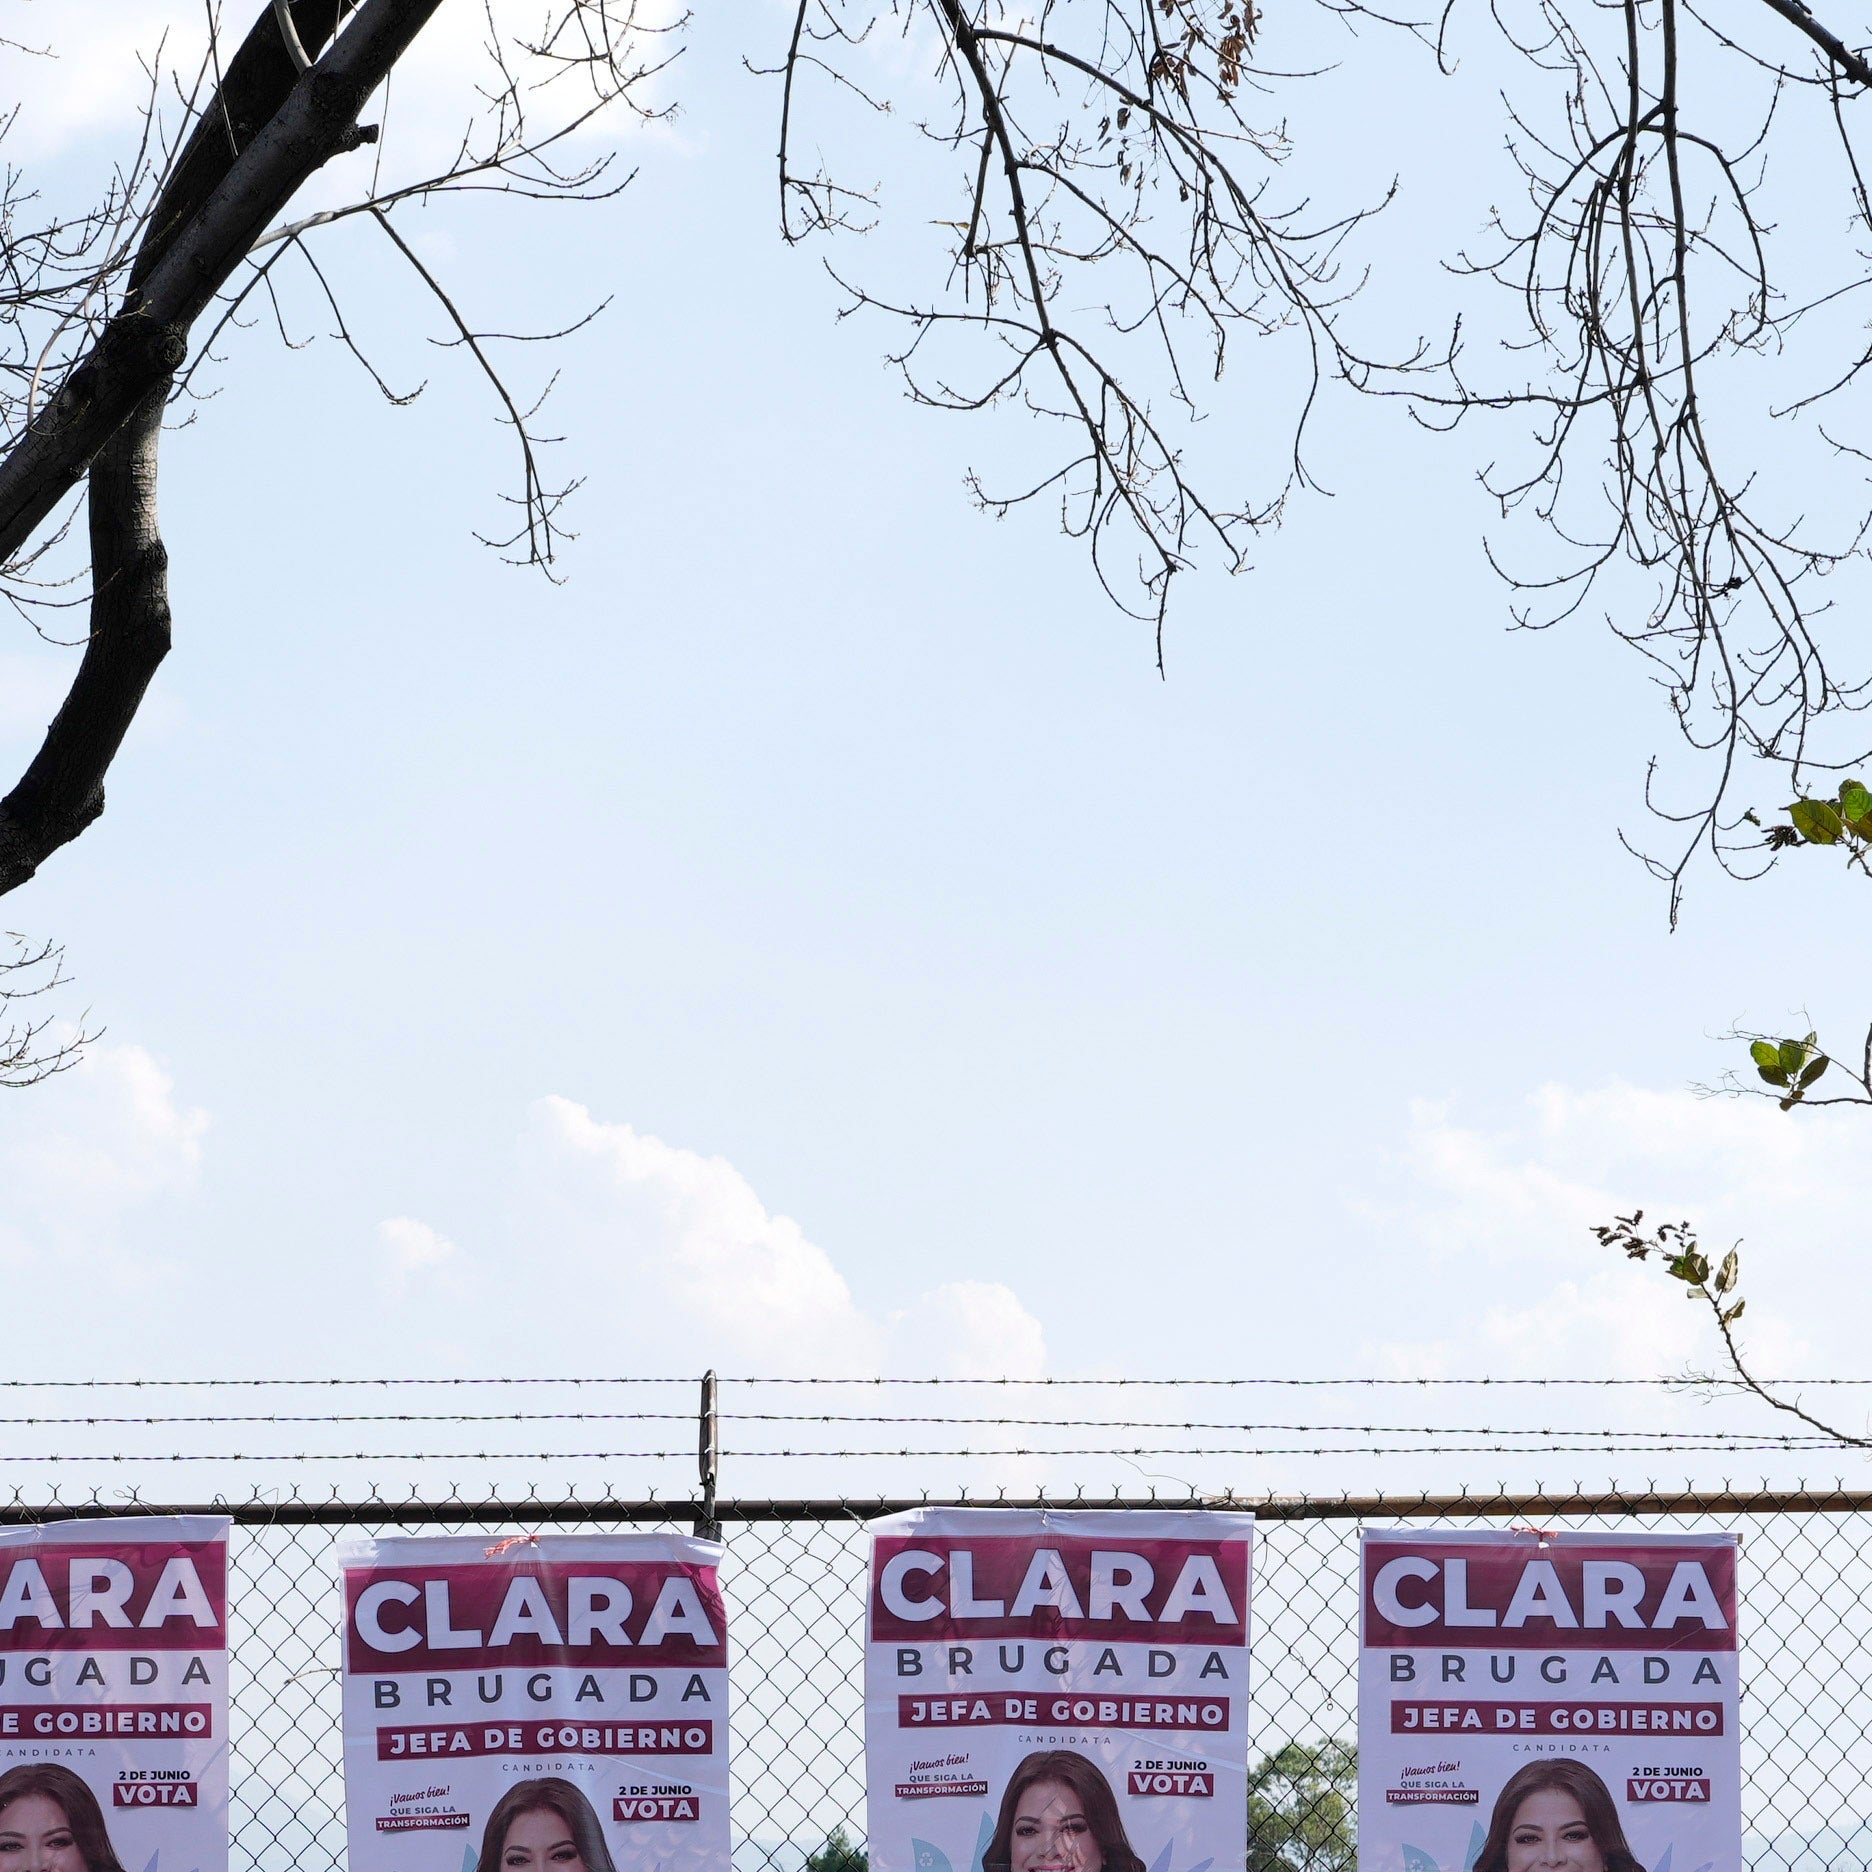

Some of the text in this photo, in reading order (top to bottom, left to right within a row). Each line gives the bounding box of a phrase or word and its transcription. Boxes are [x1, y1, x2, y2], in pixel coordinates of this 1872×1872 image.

[879, 1547, 1239, 1626] CLARA
[1373, 1555, 1730, 1631] CLARA
[353, 1575, 720, 1655] CLARA
[897, 1645, 1230, 1680] BRUGADA
[1389, 1654, 1723, 1686] BRUGADA
[374, 1674, 713, 1710] BRUGADA
[34, 1711, 207, 1734] GOBIERNO
[911, 1699, 1224, 1725] JEFA DE GOBIERNO
[1403, 1707, 1718, 1731] JEFA DE GOBIERNO
[389, 1726, 707, 1755] JEFA DE GOBIERNO
[1512, 1744, 1611, 1753] CANDIDATA
[1632, 1767, 1704, 1777] 2 DE JUNIO
[118, 1784, 193, 1805] VOTA
[1133, 1774, 1209, 1794] VOTA
[1401, 1781, 1422, 1789] QUE
[1425, 1781, 1449, 1789] SIGA
[1632, 1781, 1706, 1800] VOTA
[1388, 1792, 1478, 1801] TRANSFORMACIÓN
[619, 1799, 695, 1820] VOTA
